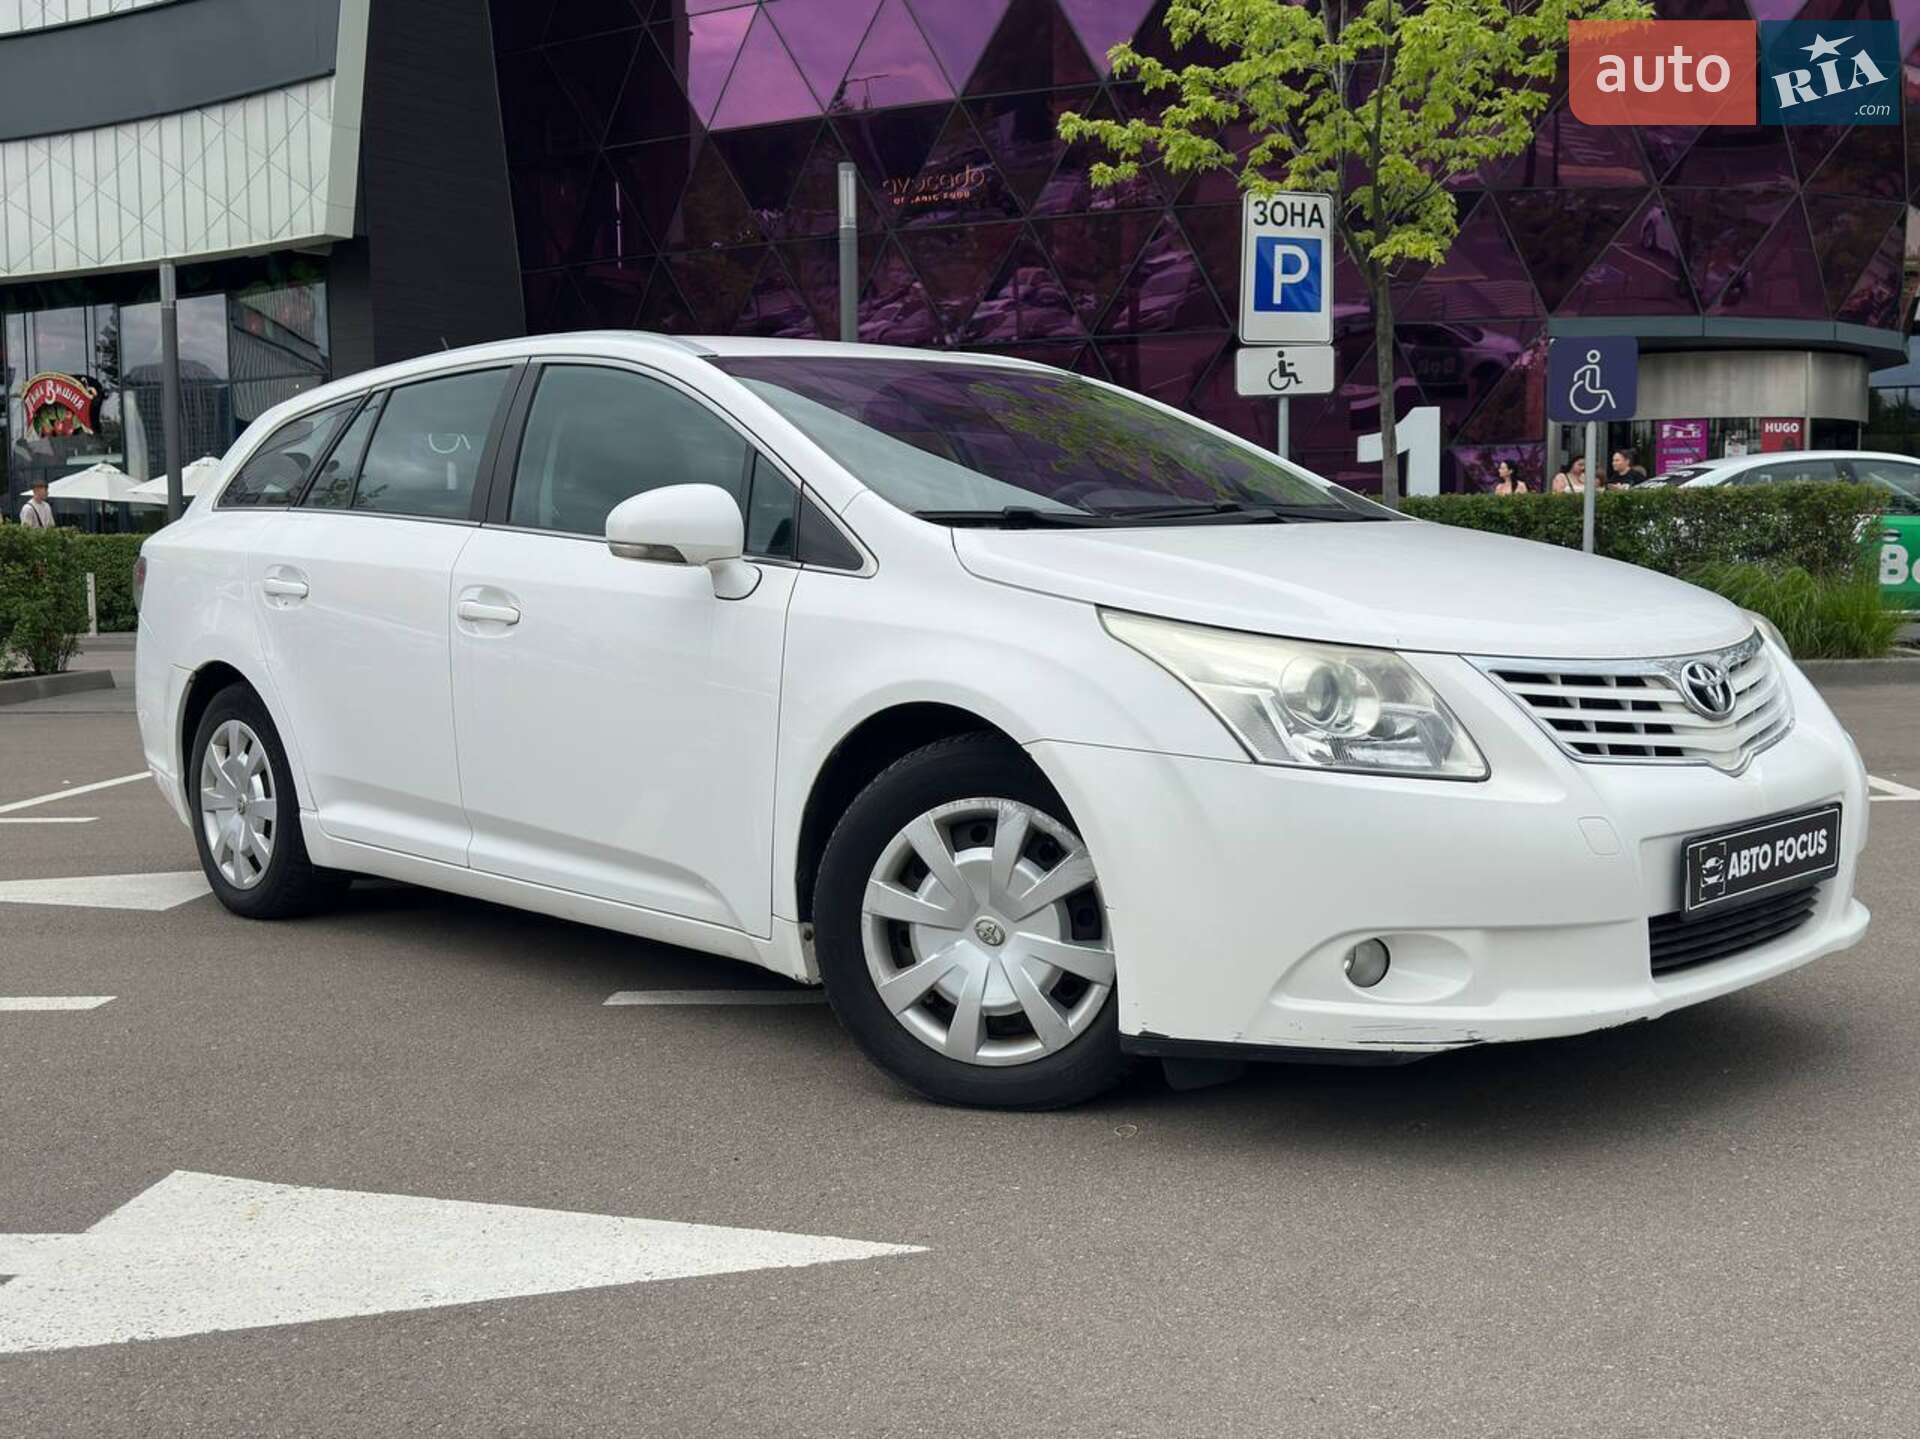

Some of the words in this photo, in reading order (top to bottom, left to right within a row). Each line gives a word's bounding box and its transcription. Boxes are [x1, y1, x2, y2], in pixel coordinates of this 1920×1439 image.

[1253, 201, 1325, 228] ЗОНА
[1272, 244, 1310, 305] P
[1764, 422, 1800, 433] HUGO
[1727, 845, 1772, 880] АВТО
[1774, 828, 1828, 867] FOCUS
